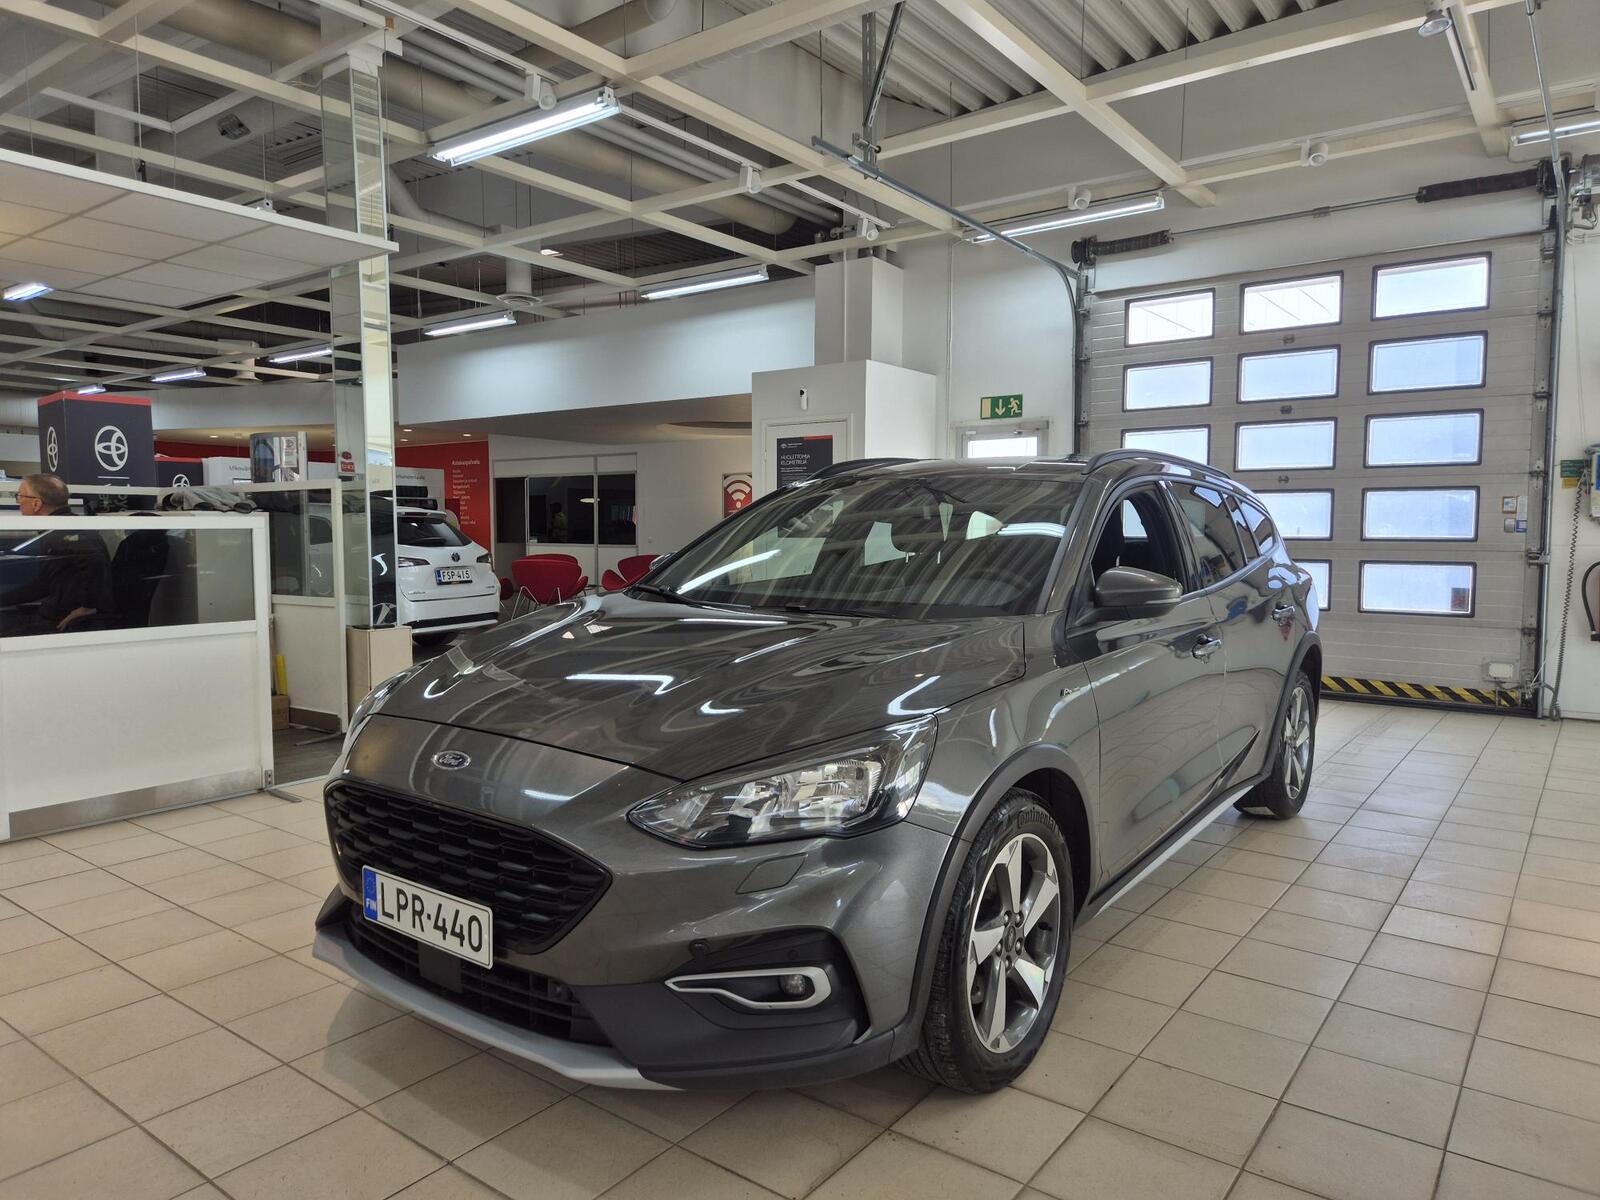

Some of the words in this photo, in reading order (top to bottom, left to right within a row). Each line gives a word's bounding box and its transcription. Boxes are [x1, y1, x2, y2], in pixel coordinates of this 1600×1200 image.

[441, 569, 471, 581] FSP-415
[365, 898, 377, 912] FIN
[380, 881, 483, 953] LPR-440
